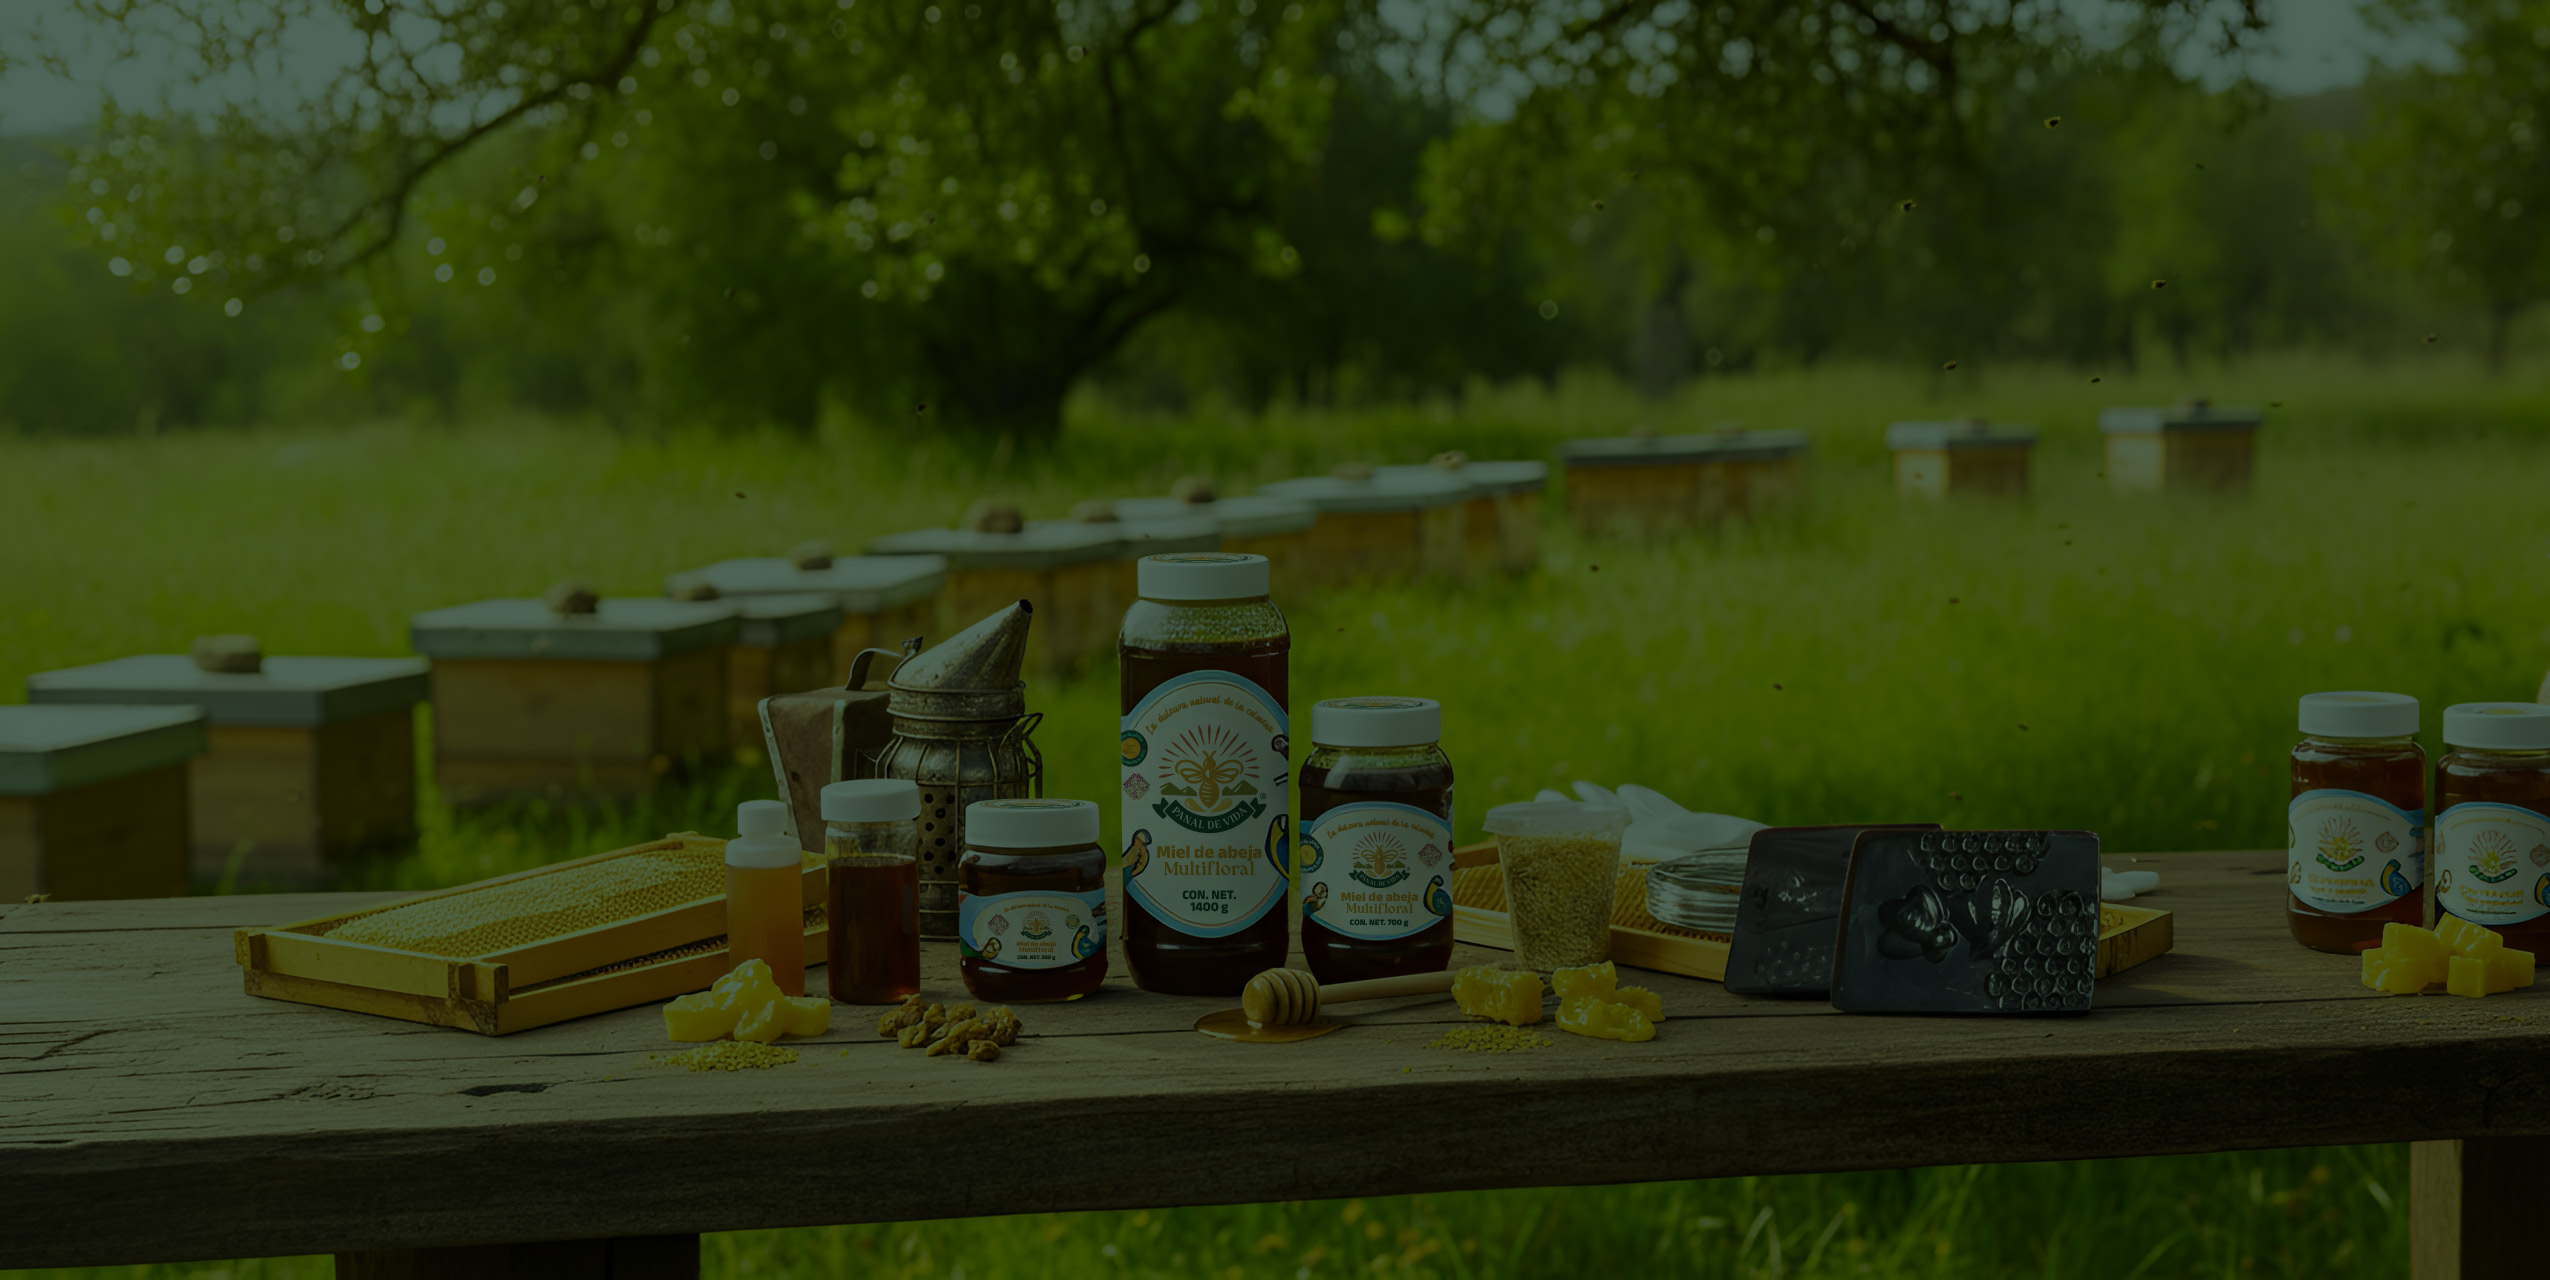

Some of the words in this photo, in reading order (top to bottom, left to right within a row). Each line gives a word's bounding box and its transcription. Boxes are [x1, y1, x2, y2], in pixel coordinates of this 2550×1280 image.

[1158, 701, 1188, 723] dulzura
[1190, 694, 1221, 706] natural
[1224, 696, 1234, 706] de
[1235, 700, 1245, 711] la
[1246, 708, 1275, 733] colmena
[1171, 807, 1205, 830] PANAL
[1207, 818, 1222, 830] DE
[1223, 807, 1248, 828] VIDA
[1156, 845, 1191, 859] Miel
[1194, 845, 1216, 859] de
[1219, 845, 1262, 861] abeja
[1163, 860, 1255, 876] Multifloral
[1359, 873, 1377, 886] PANAL
[1386, 874, 1401, 885] VIDA
[1182, 890, 1209, 900] CON.
[1211, 890, 1237, 900] NET.
[1340, 891, 1366, 902] Miel
[1368, 891, 1385, 902] de
[1387, 891, 1418, 903] abeja
[1190, 902, 1219, 912] 1400
[1220, 904, 1229, 914] g
[1346, 902, 1413, 914] Multifloral
